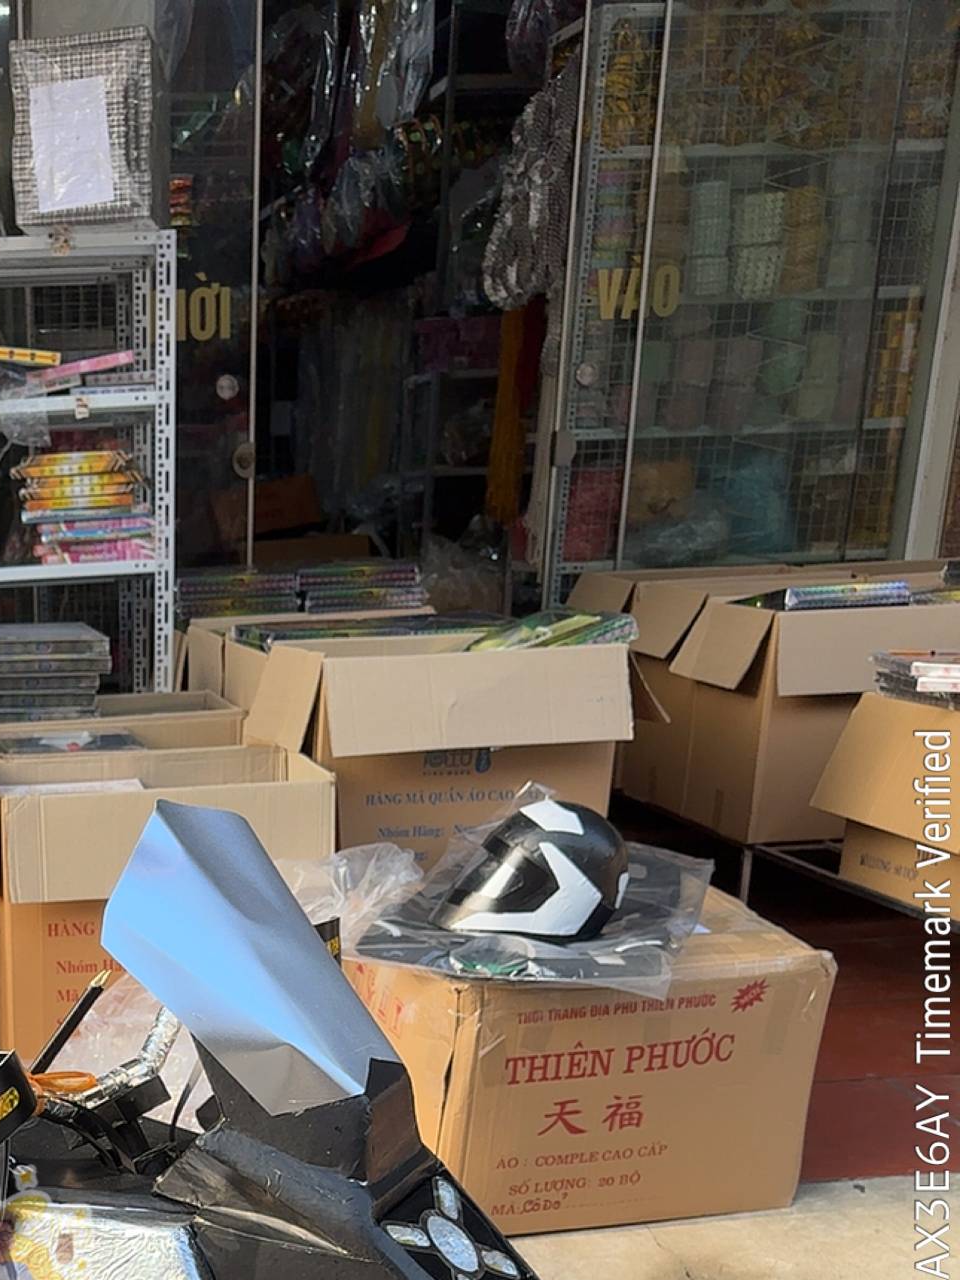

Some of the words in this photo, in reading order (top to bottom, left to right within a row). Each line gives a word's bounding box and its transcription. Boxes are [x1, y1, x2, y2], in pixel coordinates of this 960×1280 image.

[47, 918, 96, 938] HÀNG
[56, 960, 98, 975] Nhóm
[504, 1040, 616, 1086] THIÊN
[623, 1027, 736, 1075] PHƯỚC
[534, 1150, 600, 1168] COMPLE
[601, 1147, 634, 1163] CAO
[597, 1175, 616, 1188] 20
